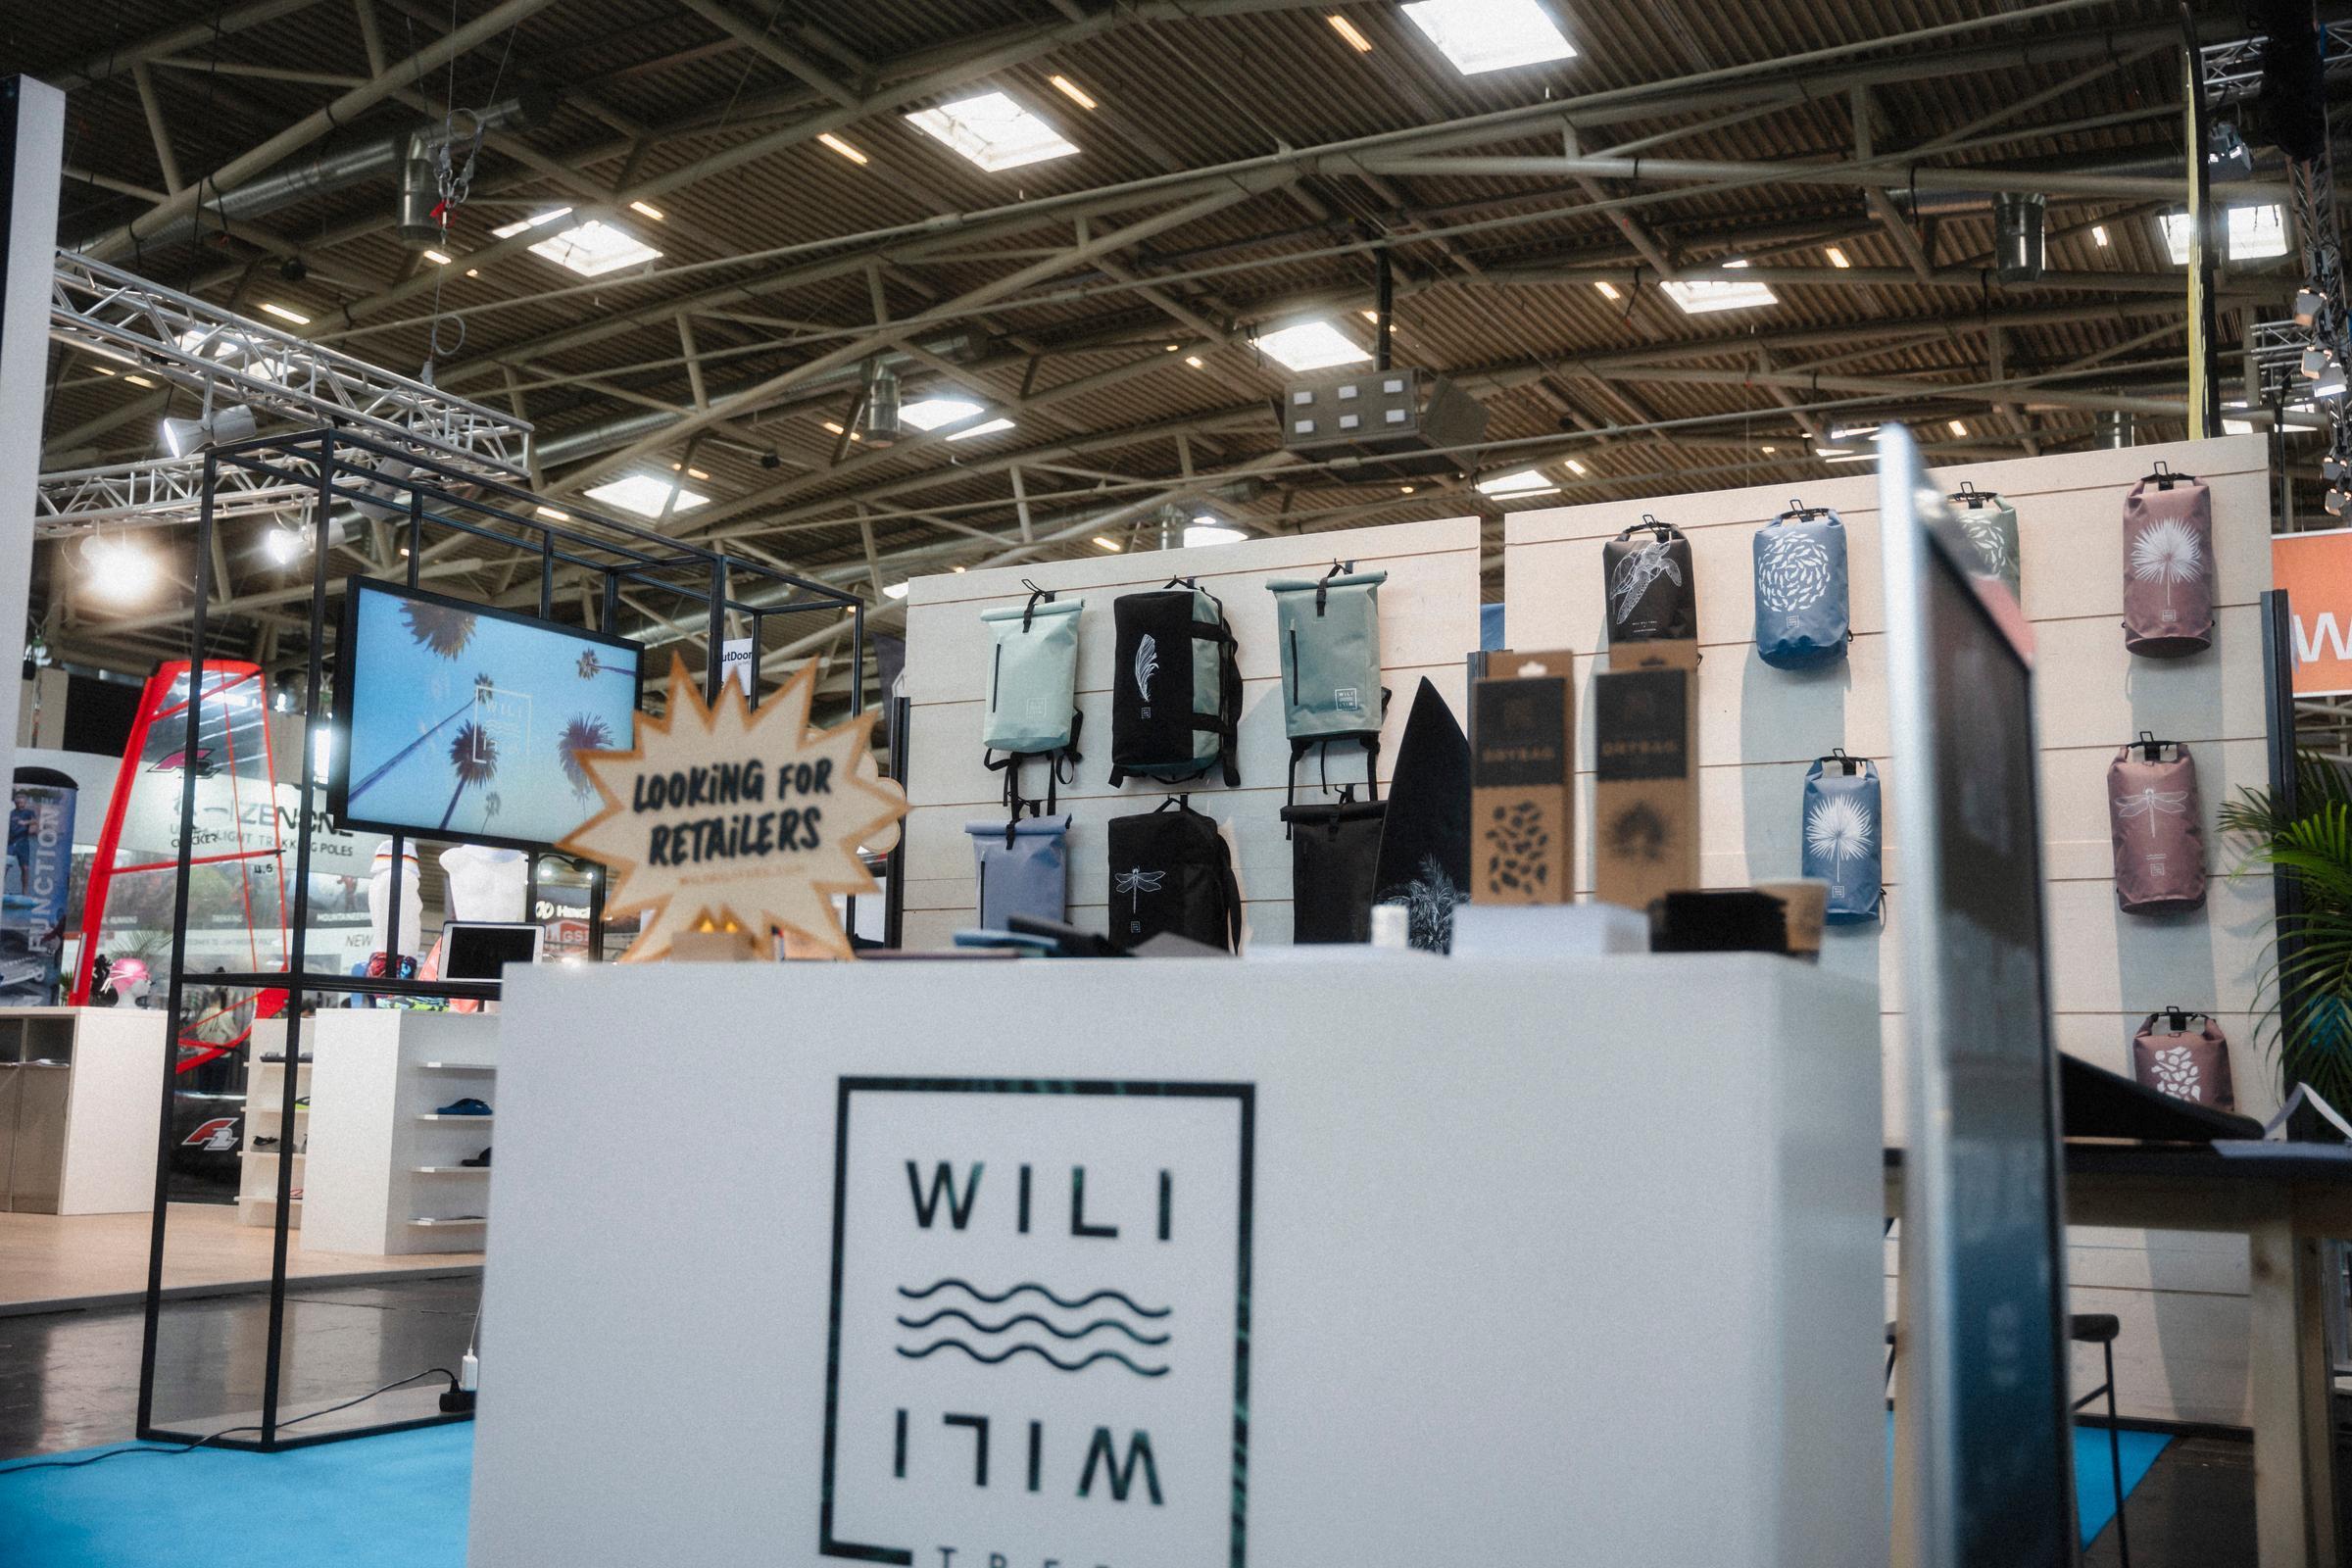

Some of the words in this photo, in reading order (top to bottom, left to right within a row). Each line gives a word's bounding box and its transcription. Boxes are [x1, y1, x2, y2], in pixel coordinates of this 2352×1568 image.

[721, 651, 753, 662] utDoor
[778, 758, 833, 800] FOR
[319, 843, 354, 857] POLES
[27, 807, 61, 953] FUNCTION
[346, 934, 374, 947] NEW
[906, 1160, 1171, 1241] WILI
[894, 1408, 1163, 1505] WILI
